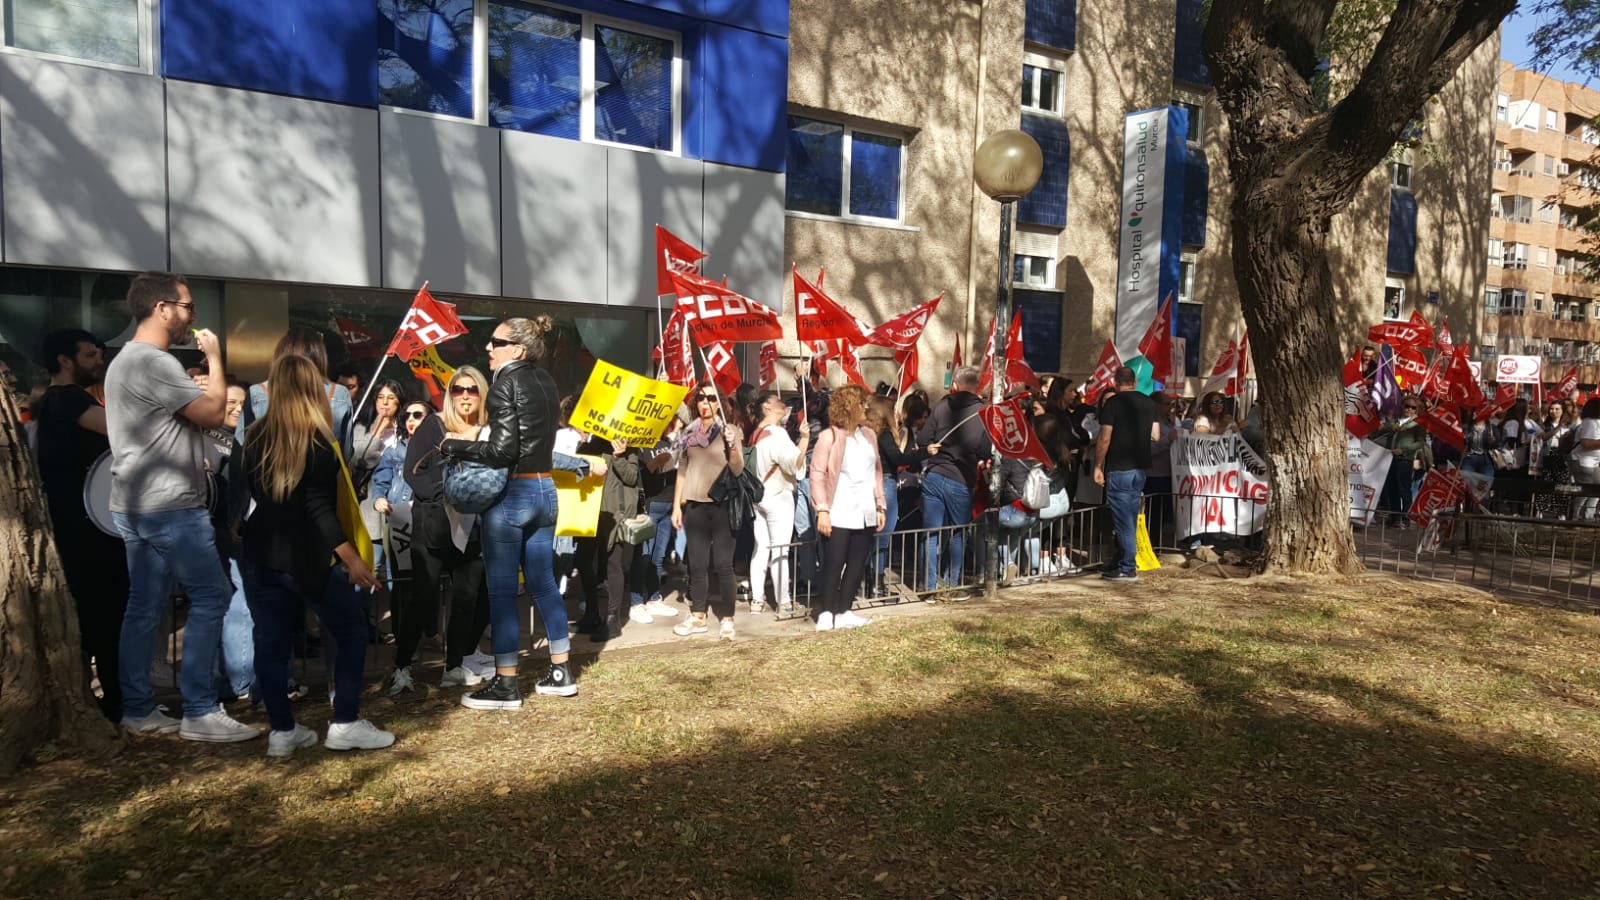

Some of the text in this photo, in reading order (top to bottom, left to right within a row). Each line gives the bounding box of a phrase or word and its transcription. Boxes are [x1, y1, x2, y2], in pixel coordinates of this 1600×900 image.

[1151, 119, 1159, 152] Murcia
[1128, 121, 1147, 292] Hospital quironsalud
[602, 372, 622, 389] LA
[583, 420, 608, 437] CON
[588, 409, 653, 437] NO NEGOCIA
